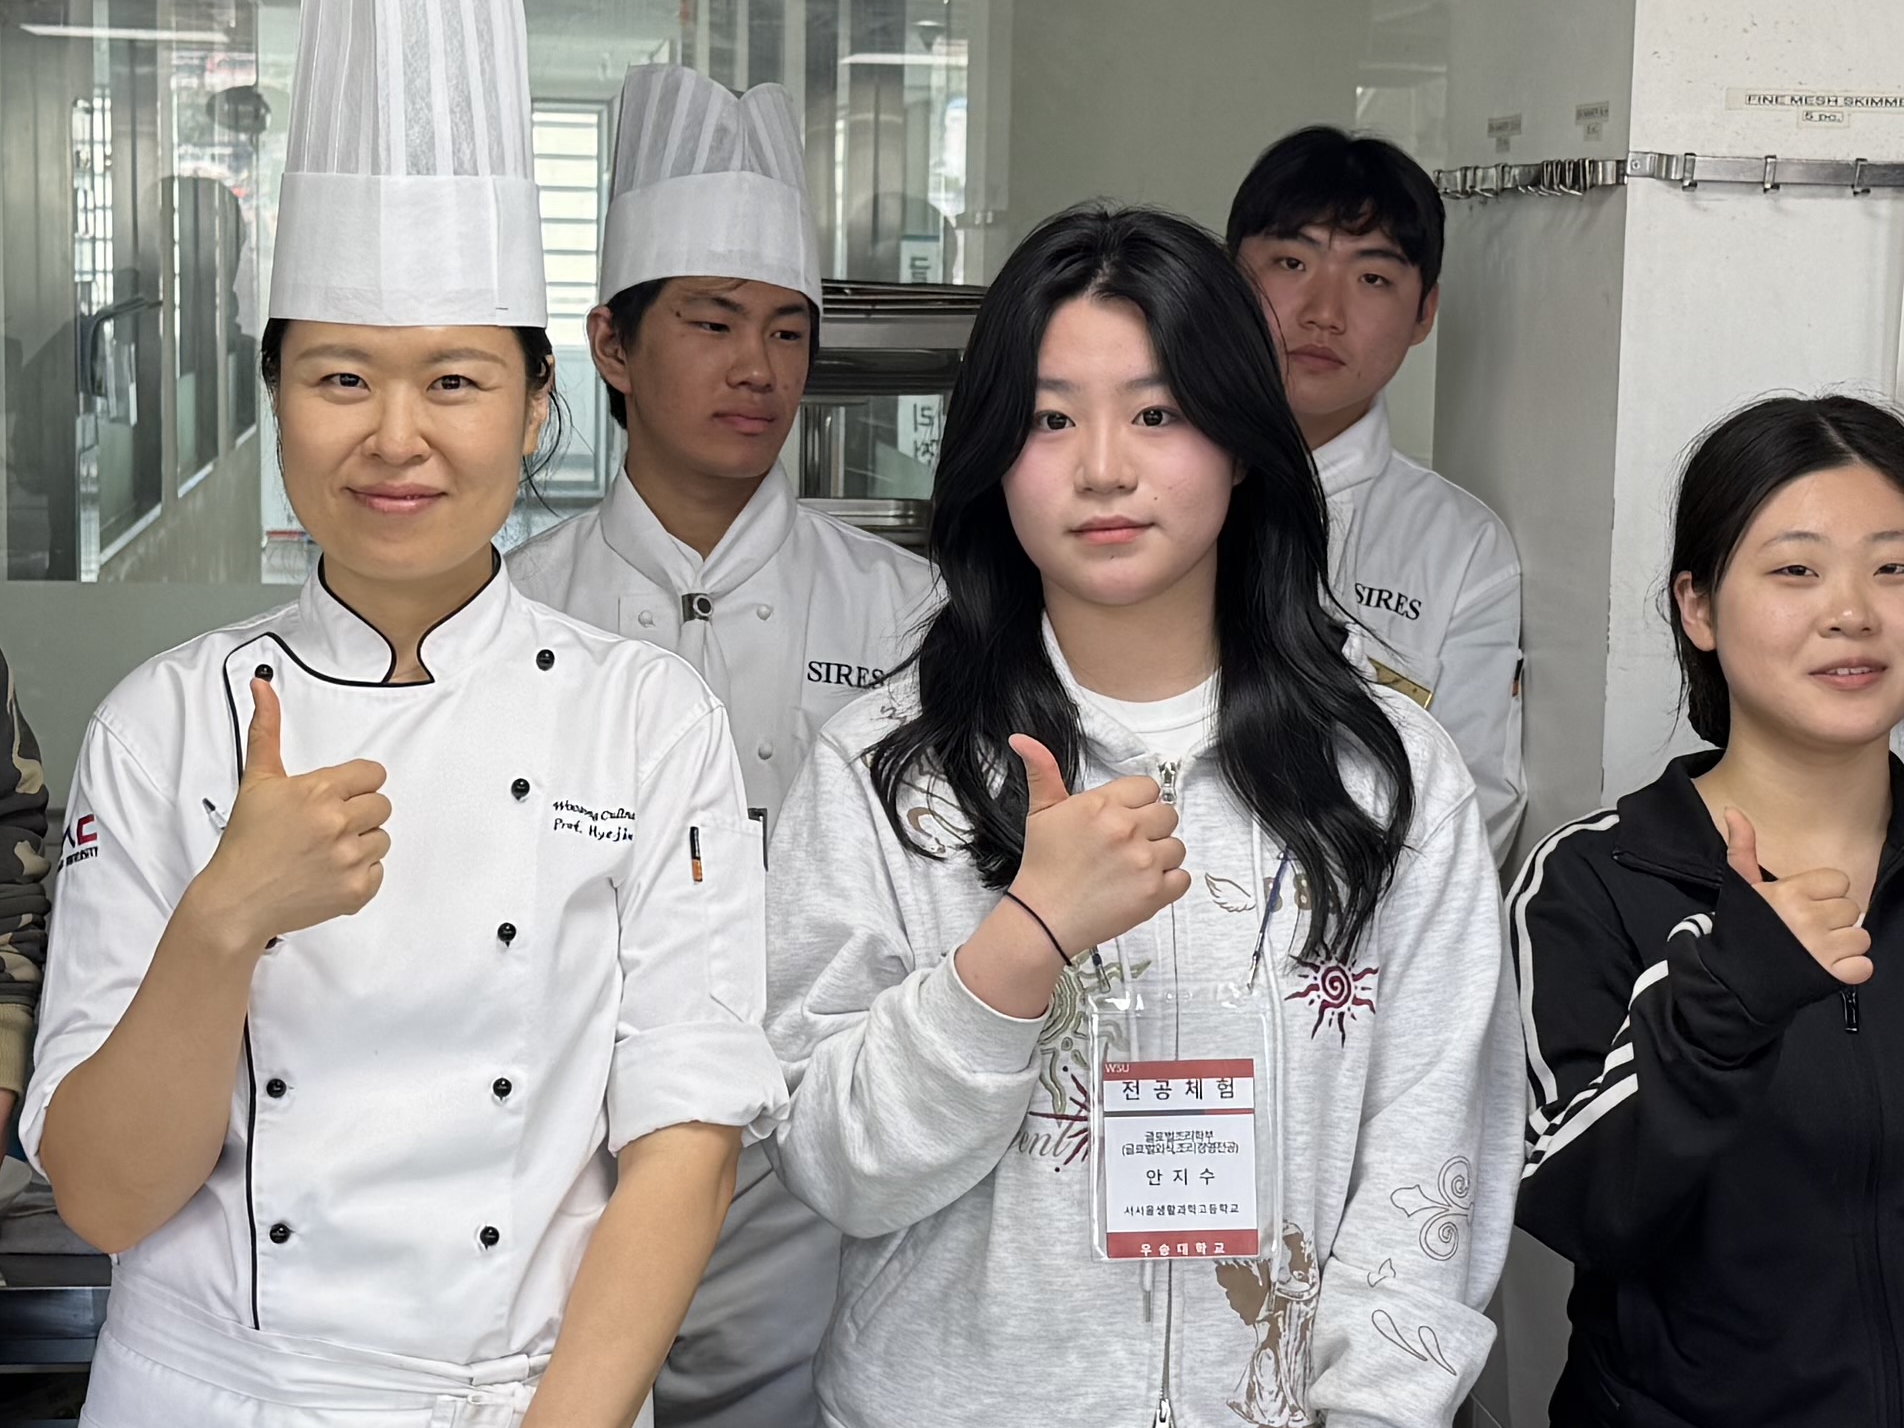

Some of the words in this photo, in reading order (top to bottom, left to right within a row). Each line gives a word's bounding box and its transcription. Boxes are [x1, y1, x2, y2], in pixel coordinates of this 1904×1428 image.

[1748, 95, 1786, 105] FINE
[1790, 95, 1838, 106] MESH
[1355, 582, 1422, 620] SIRES
